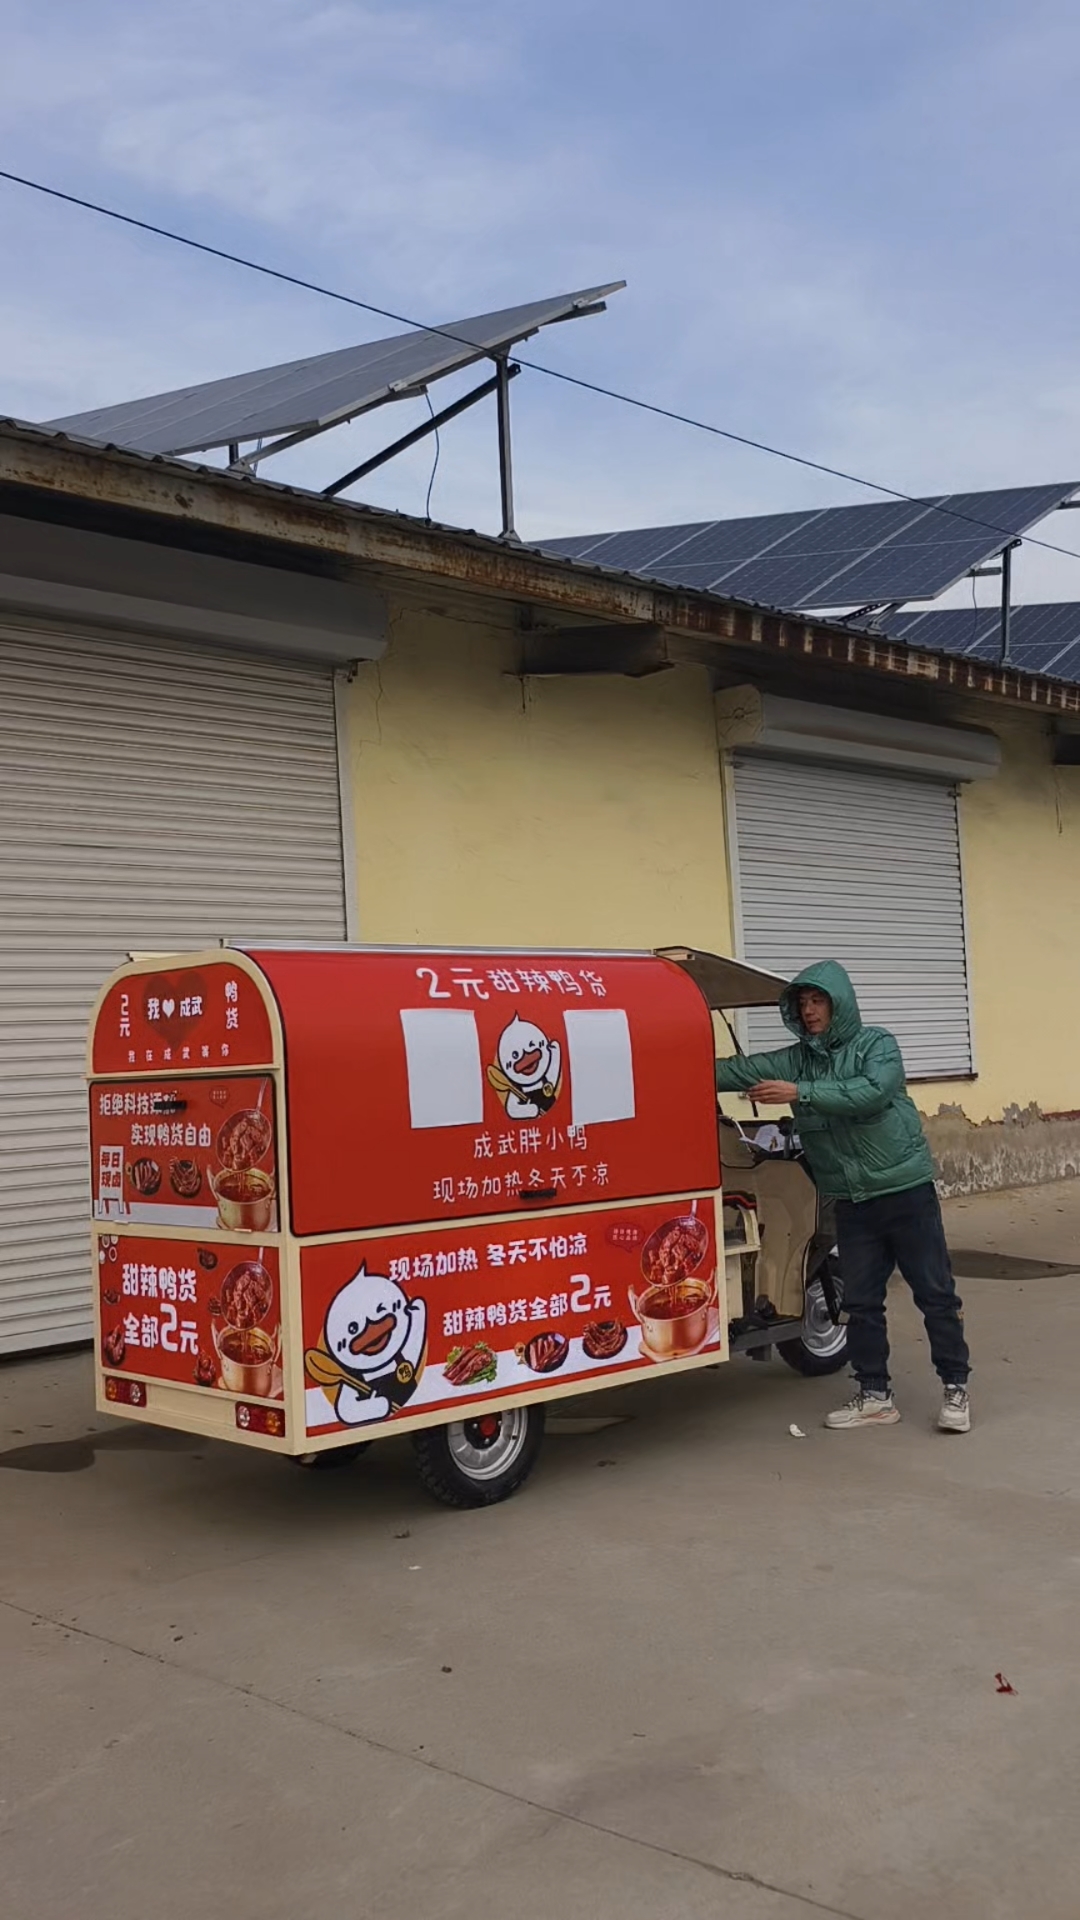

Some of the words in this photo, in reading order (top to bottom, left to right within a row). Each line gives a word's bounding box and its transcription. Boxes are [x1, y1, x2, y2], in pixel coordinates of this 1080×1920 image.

[415, 967, 607, 1000] 2元甜辣鸭货
[119, 994, 131, 1037] 2元
[147, 997, 160, 1020] 我
[180, 995, 203, 1017] 成武
[224, 980, 239, 1030] 鸭货
[130, 1122, 211, 1147] 实现鸭货自由
[473, 1124, 588, 1159] 成武胖小鸭
[101, 1151, 121, 1168] 每日
[433, 1161, 609, 1203] 现场加热冬天不凉
[389, 1247, 479, 1282] 现场加热
[486, 1232, 588, 1267] 冬天不怕凉
[122, 1263, 197, 1304] 甜辣鸭货
[442, 1273, 613, 1337] 甜辣鸭货全部2元
[122, 1302, 199, 1356] 全部2元
